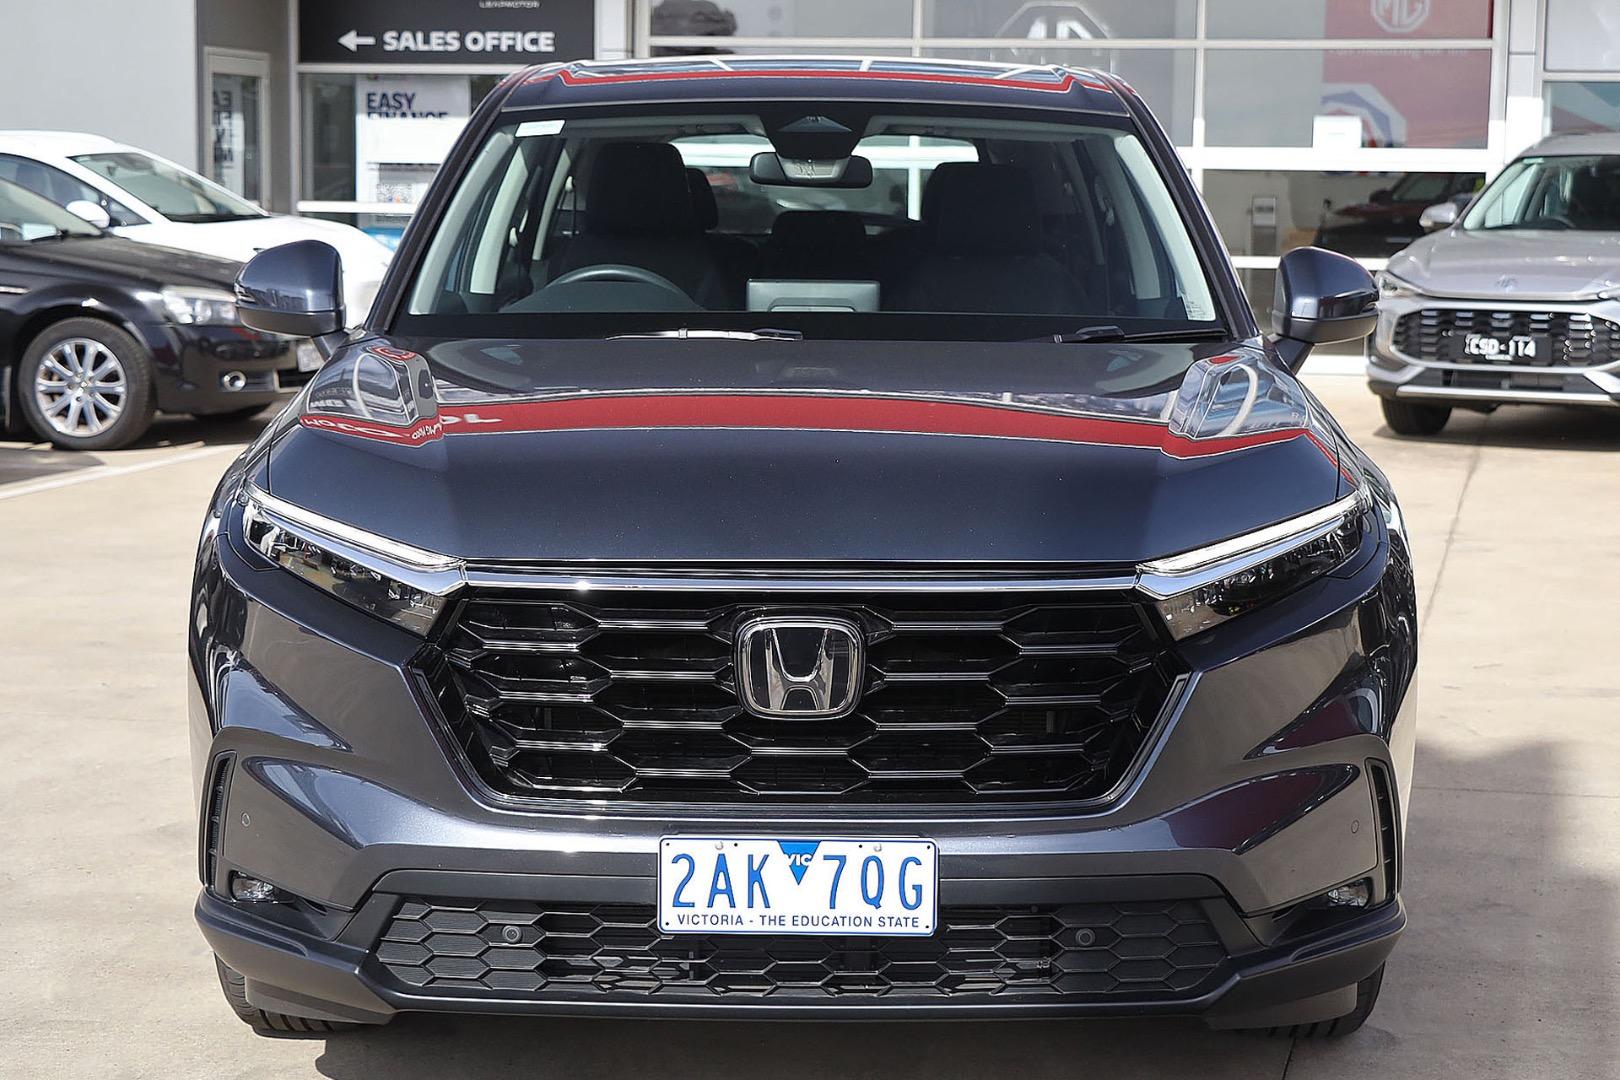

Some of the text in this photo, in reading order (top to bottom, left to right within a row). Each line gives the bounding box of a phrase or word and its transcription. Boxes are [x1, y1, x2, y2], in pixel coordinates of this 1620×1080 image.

[383, 30, 556, 52] SALES OFFICE
[367, 92, 416, 110] EASY
[785, 853, 813, 867] VIC
[671, 853, 923, 911] 2AK 7QG
[677, 914, 744, 926] VICTORIA
[759, 914, 786, 927] THE
[792, 915, 873, 928] EDUCATION
[878, 916, 920, 928] STATE
